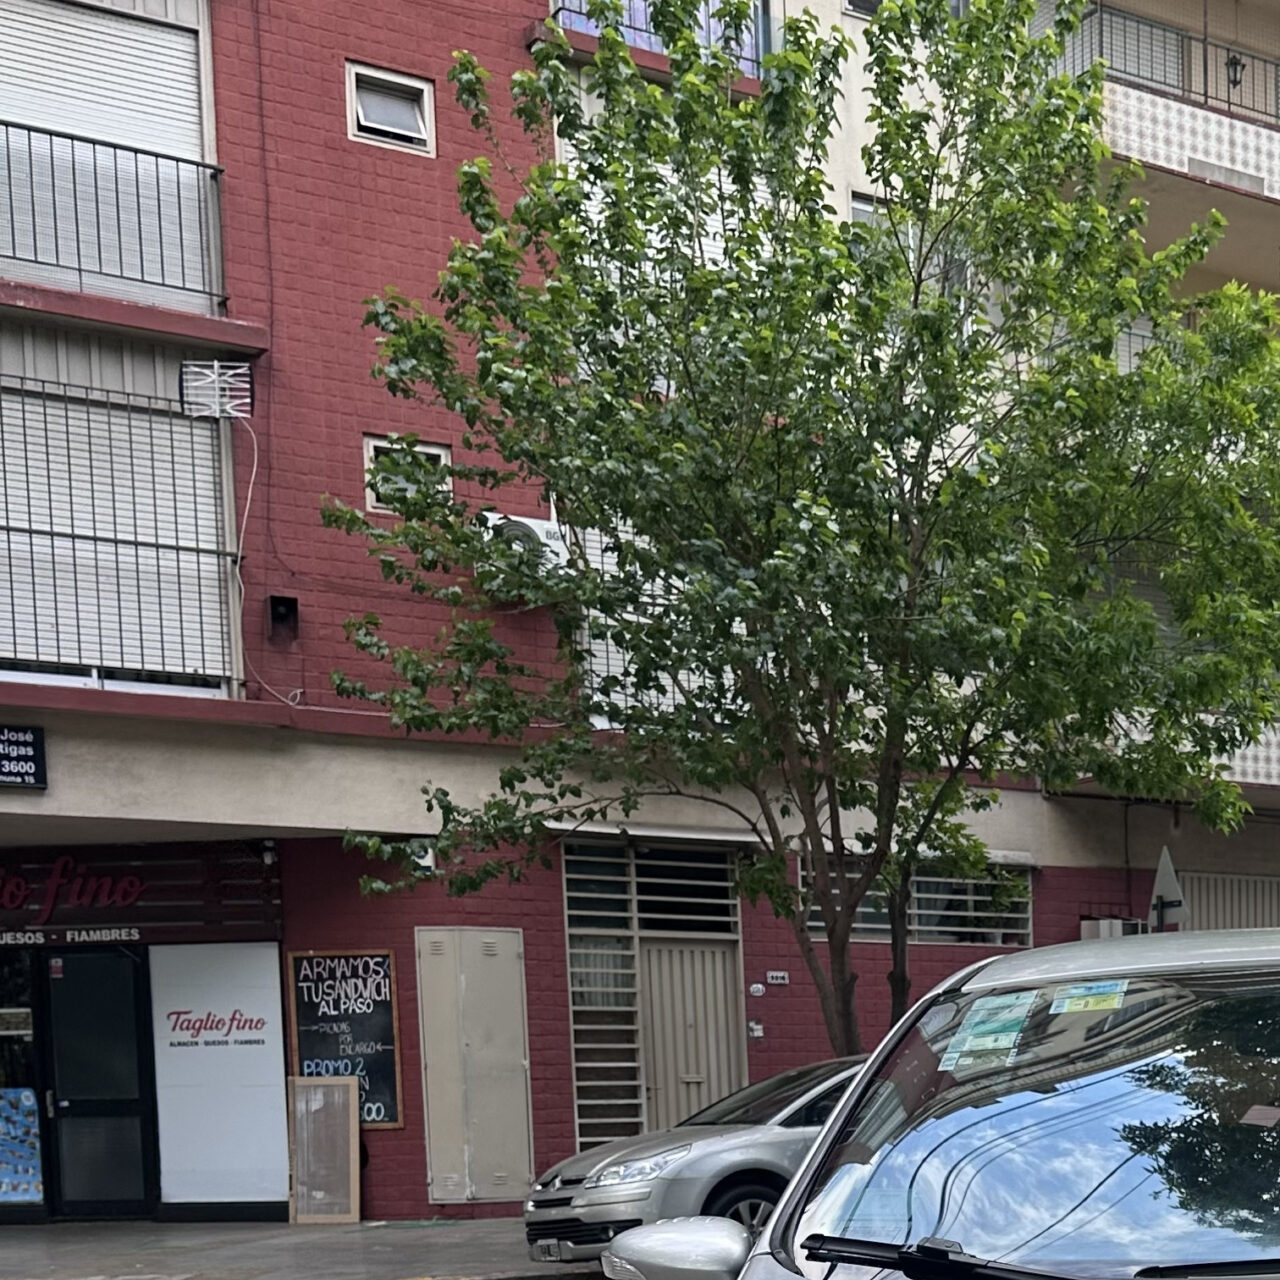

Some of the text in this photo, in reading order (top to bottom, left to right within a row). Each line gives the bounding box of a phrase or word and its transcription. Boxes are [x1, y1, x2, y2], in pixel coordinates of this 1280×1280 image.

[0, 728, 34, 742] José
[1, 760, 36, 773] 3600
[29, 855, 147, 926] fino
[66, 928, 140, 942] FIAMBRES
[299, 957, 385, 980] ARMAMOS
[298, 978, 390, 1003] TU SANDWICH
[318, 998, 374, 1017] AL PASO
[166, 1008, 268, 1039] Taglio fino
[303, 1057, 367, 1077] PROMO 2
